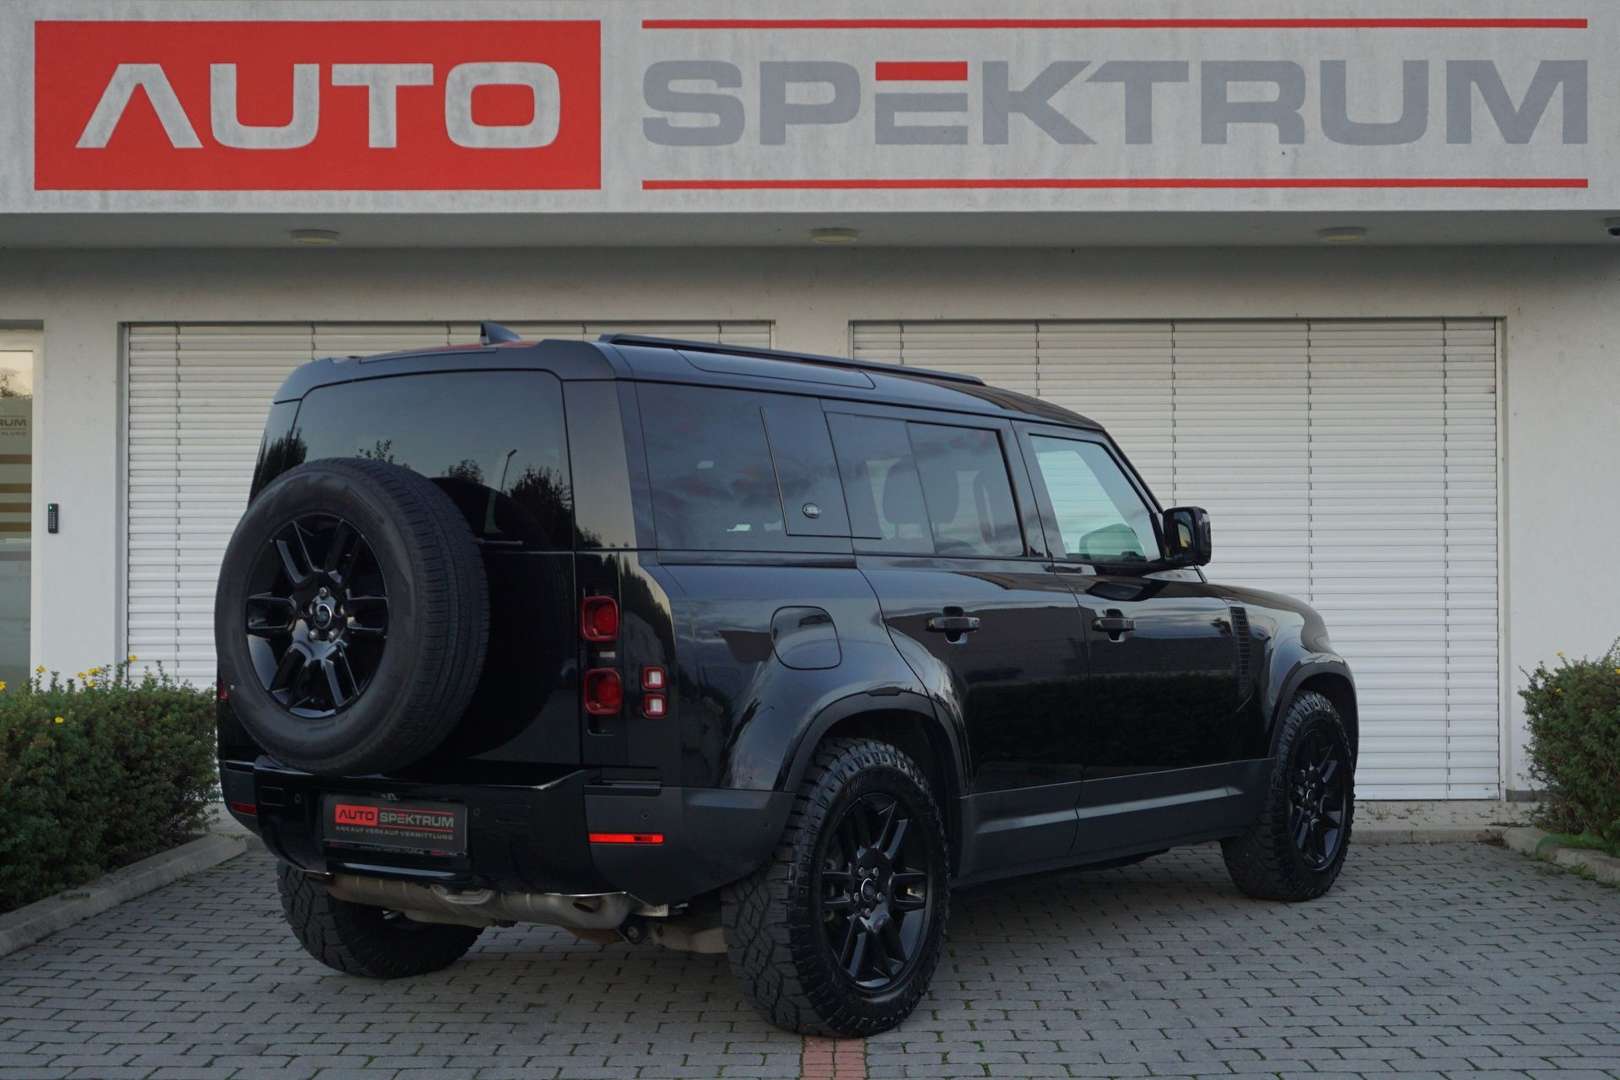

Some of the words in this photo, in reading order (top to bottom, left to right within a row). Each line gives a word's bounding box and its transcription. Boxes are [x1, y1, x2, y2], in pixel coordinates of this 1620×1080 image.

[75, 61, 561, 150] AUTO
[643, 60, 1588, 147] SPEKTRUM
[338, 808, 375, 821] AUTO
[380, 812, 455, 827] SPEKTRUM
